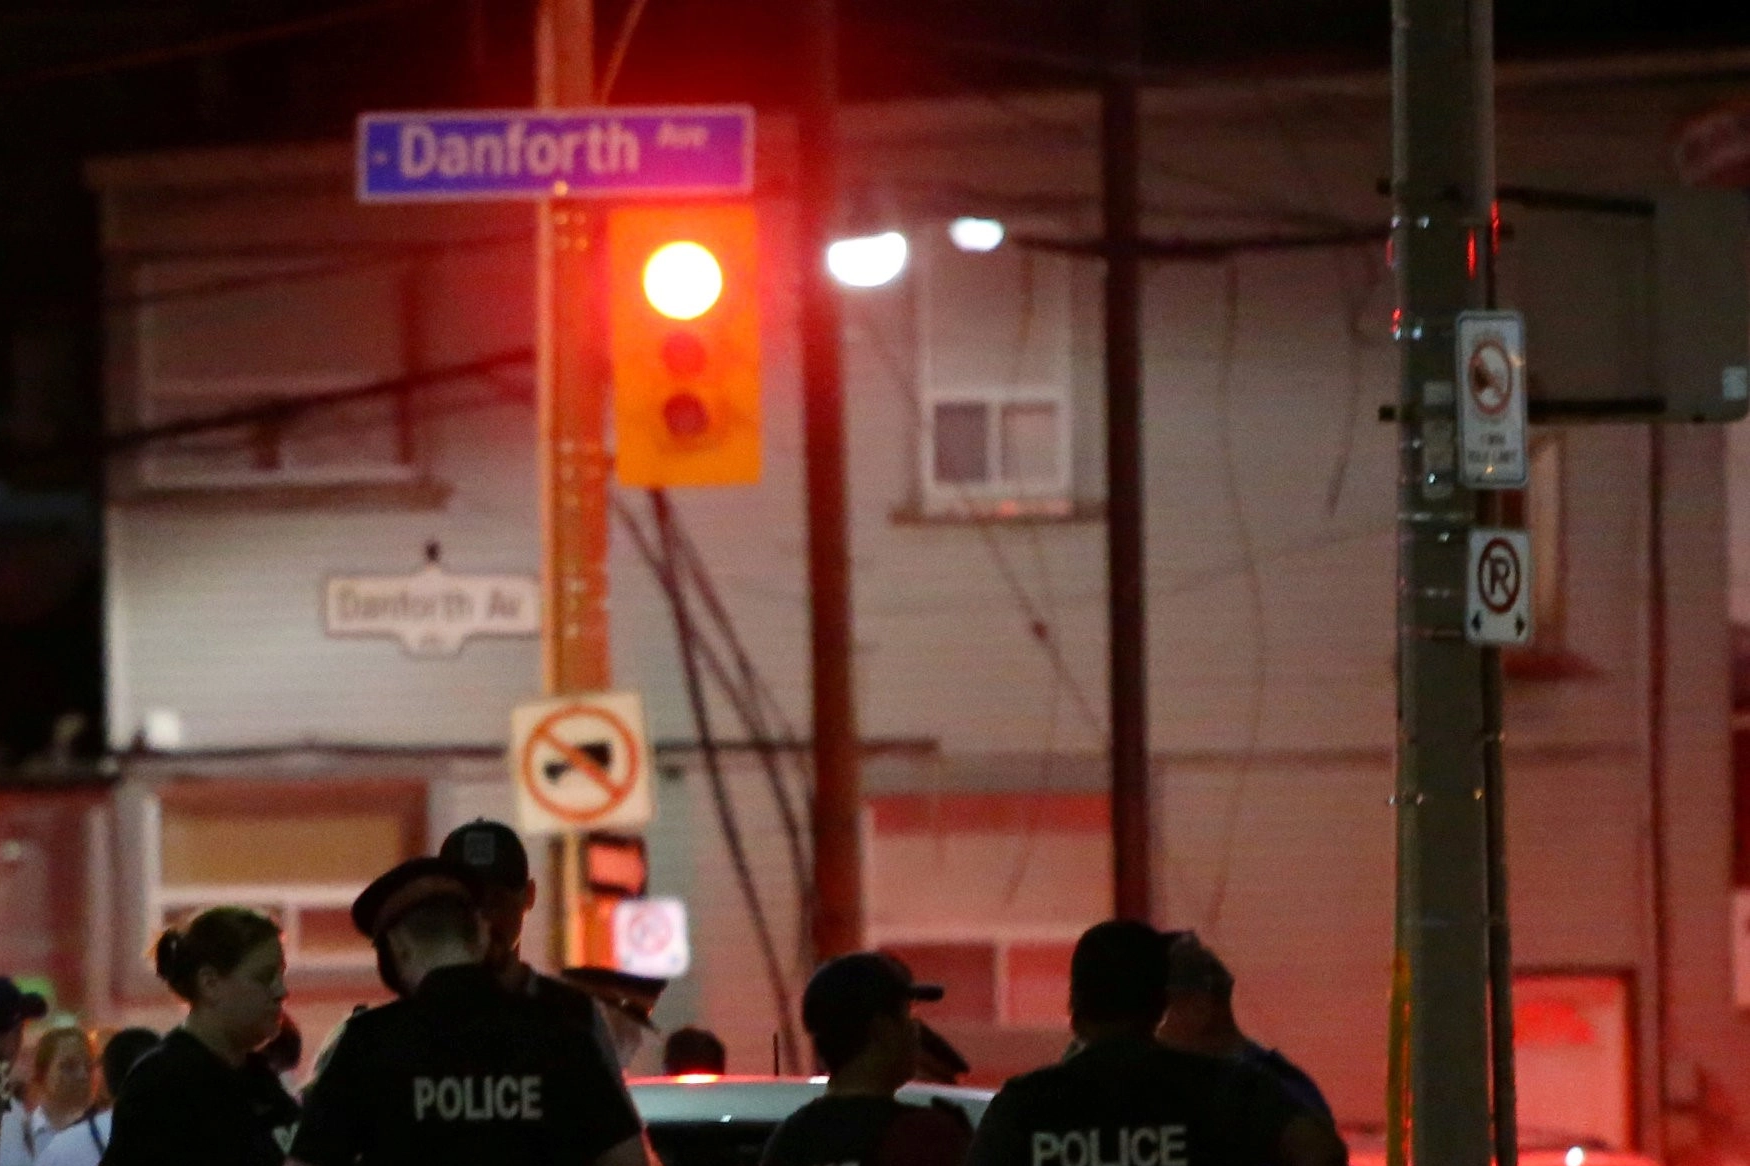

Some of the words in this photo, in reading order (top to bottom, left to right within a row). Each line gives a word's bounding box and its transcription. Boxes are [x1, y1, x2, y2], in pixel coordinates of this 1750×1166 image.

[398, 122, 642, 179] Danforth
[336, 586, 475, 624] Danforth
[412, 1074, 544, 1122] POLICE
